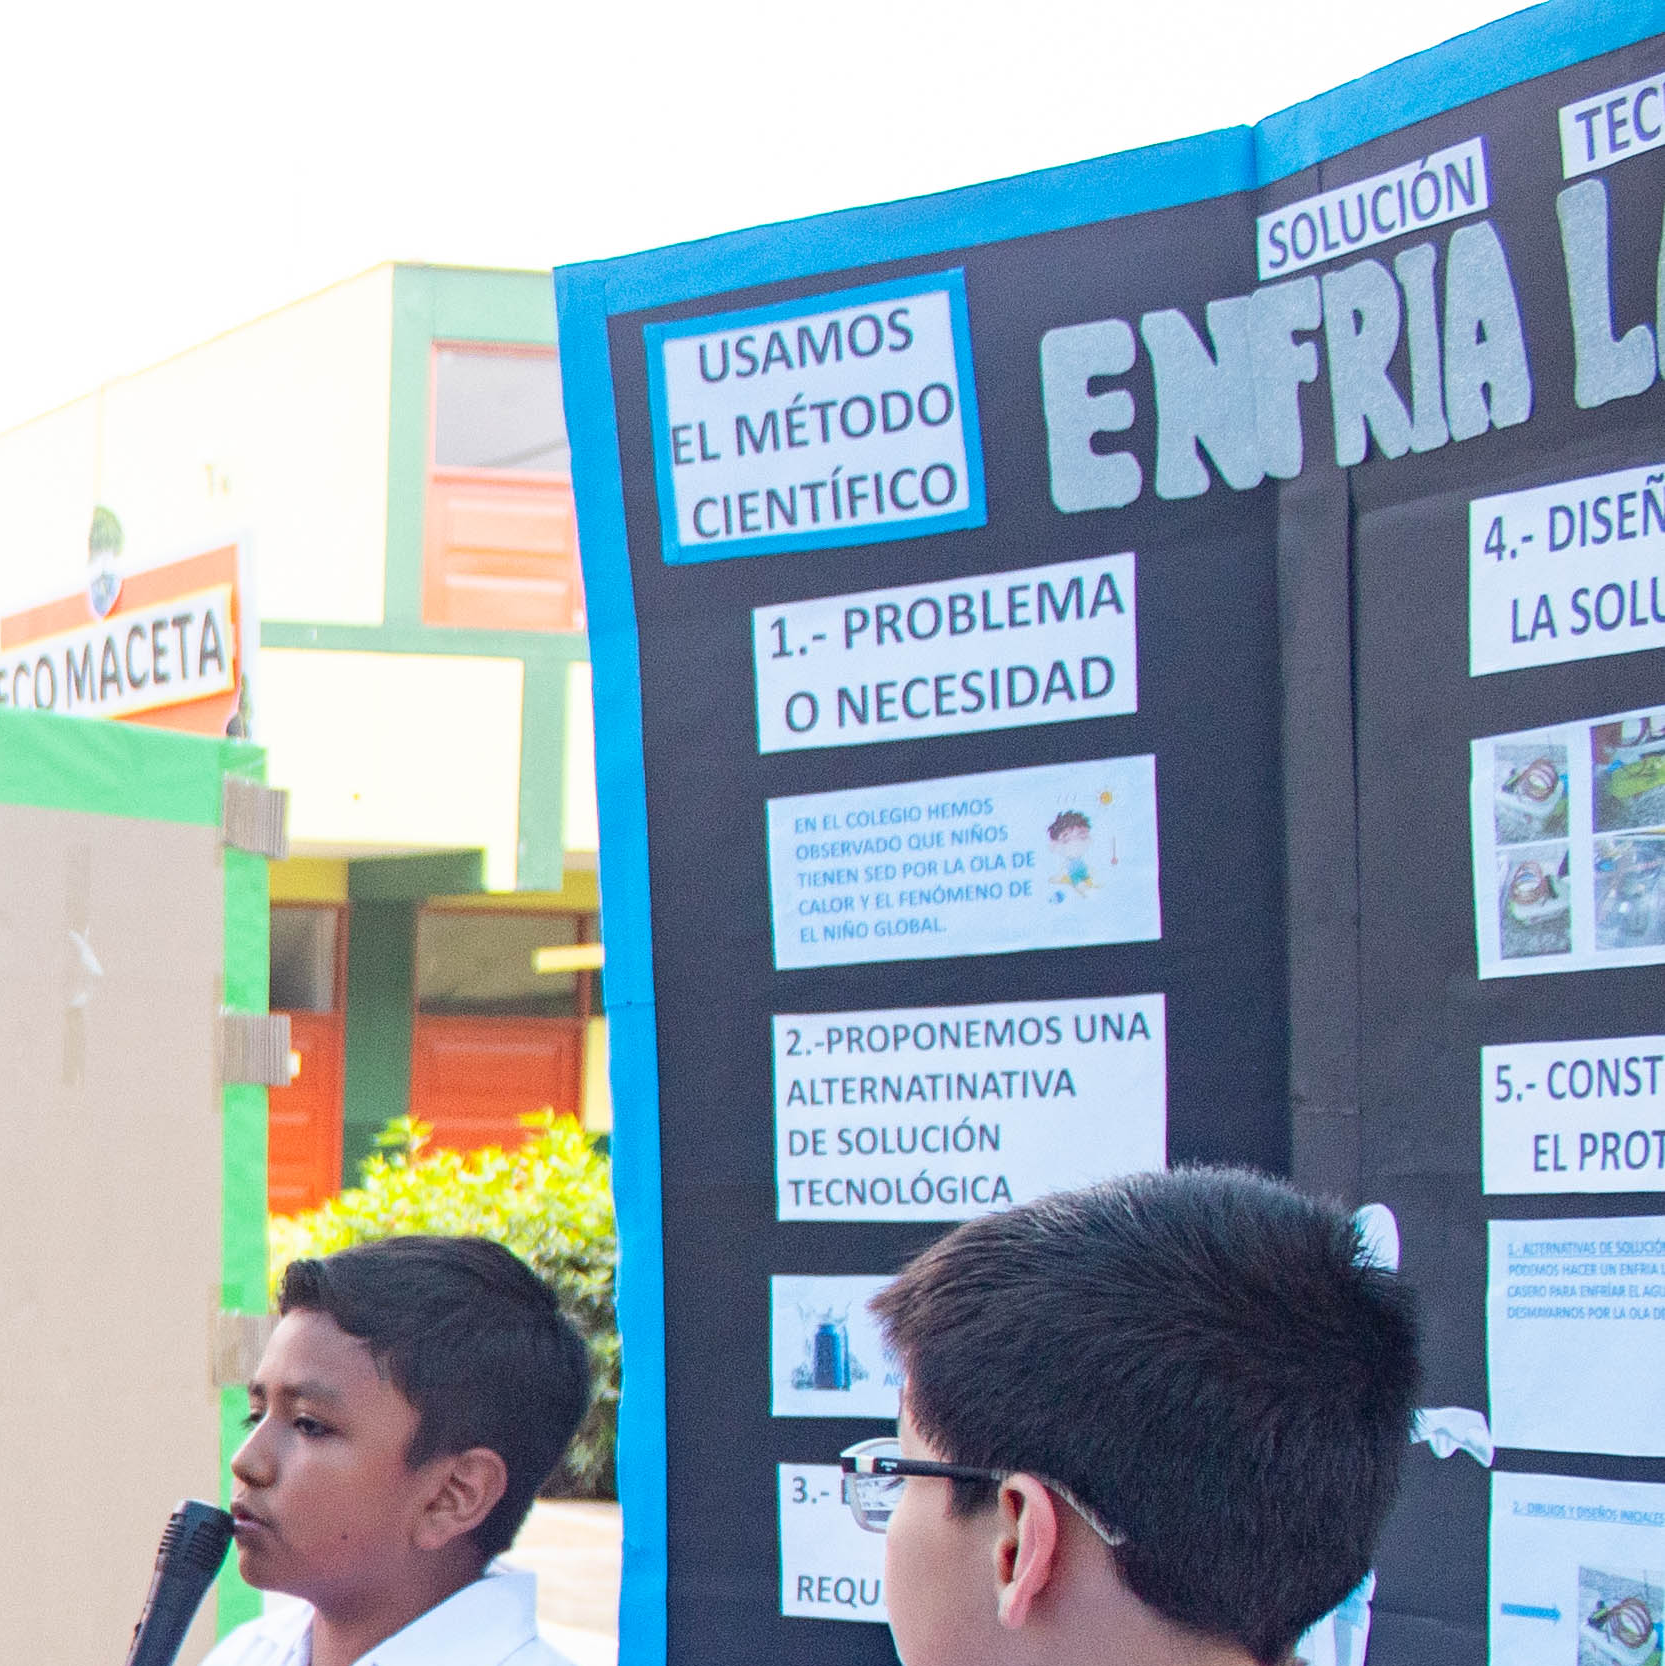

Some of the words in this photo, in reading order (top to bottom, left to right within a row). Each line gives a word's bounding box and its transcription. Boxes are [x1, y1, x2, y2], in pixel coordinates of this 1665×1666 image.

[1268, 155, 1476, 269] SOLUCIÓN
[699, 307, 913, 383] USAMOS
[1041, 219, 1533, 515] ENFRIA
[1557, 176, 1665, 410] L
[672, 421, 720, 466] EL
[735, 382, 954, 456] MÉTODO
[692, 463, 957, 538] CIENTÍFICO
[1484, 516, 1533, 562] 4.-
[770, 617, 827, 659] 1.-
[844, 572, 1124, 649] PROBLEMA
[1512, 594, 1557, 643] LA
[66, 609, 225, 708] MACETA
[785, 691, 819, 733] O
[838, 656, 1116, 728] NECESIDAD
[795, 816, 816, 834] EN
[823, 815, 842, 831] EL
[846, 805, 921, 830] COLEGIO
[928, 799, 993, 820] HEMOS
[796, 837, 901, 861] OBSERVADO
[909, 832, 944, 850] QUE
[951, 822, 1008, 844] NIÑOS
[797, 867, 858, 888] TIENEN
[865, 862, 896, 881] SED
[903, 860, 937, 878] POR
[945, 857, 965, 876] LA
[970, 854, 1006, 873] OLA
[1013, 851, 1035, 868] DE
[798, 896, 854, 916] CALOR
[861, 894, 869, 911] Y
[876, 892, 892, 908] EL
[899, 883, 1003, 907] FENÓMENO
[1009, 880, 1033, 898] DE
[800, 927, 817, 943] EL
[824, 921, 868, 942] NIÑO
[875, 918, 946, 937] GLOBAL.
[786, 1015, 1061, 1056] 2.-PROPONEMOS
[1075, 1012, 1151, 1043] UNA
[787, 1068, 1077, 1107] ALTERNATINATIVA
[1496, 1064, 1536, 1102] 5.-
[1548, 1055, 1663, 1100] CONST
[789, 1129, 827, 1156] DE
[838, 1116, 1001, 1155] SOLUCIÓN
[1534, 1134, 1567, 1172] EL
[789, 1170, 1013, 1206] TECNOLÓGICA
[792, 1477, 829, 1504] 3.-
